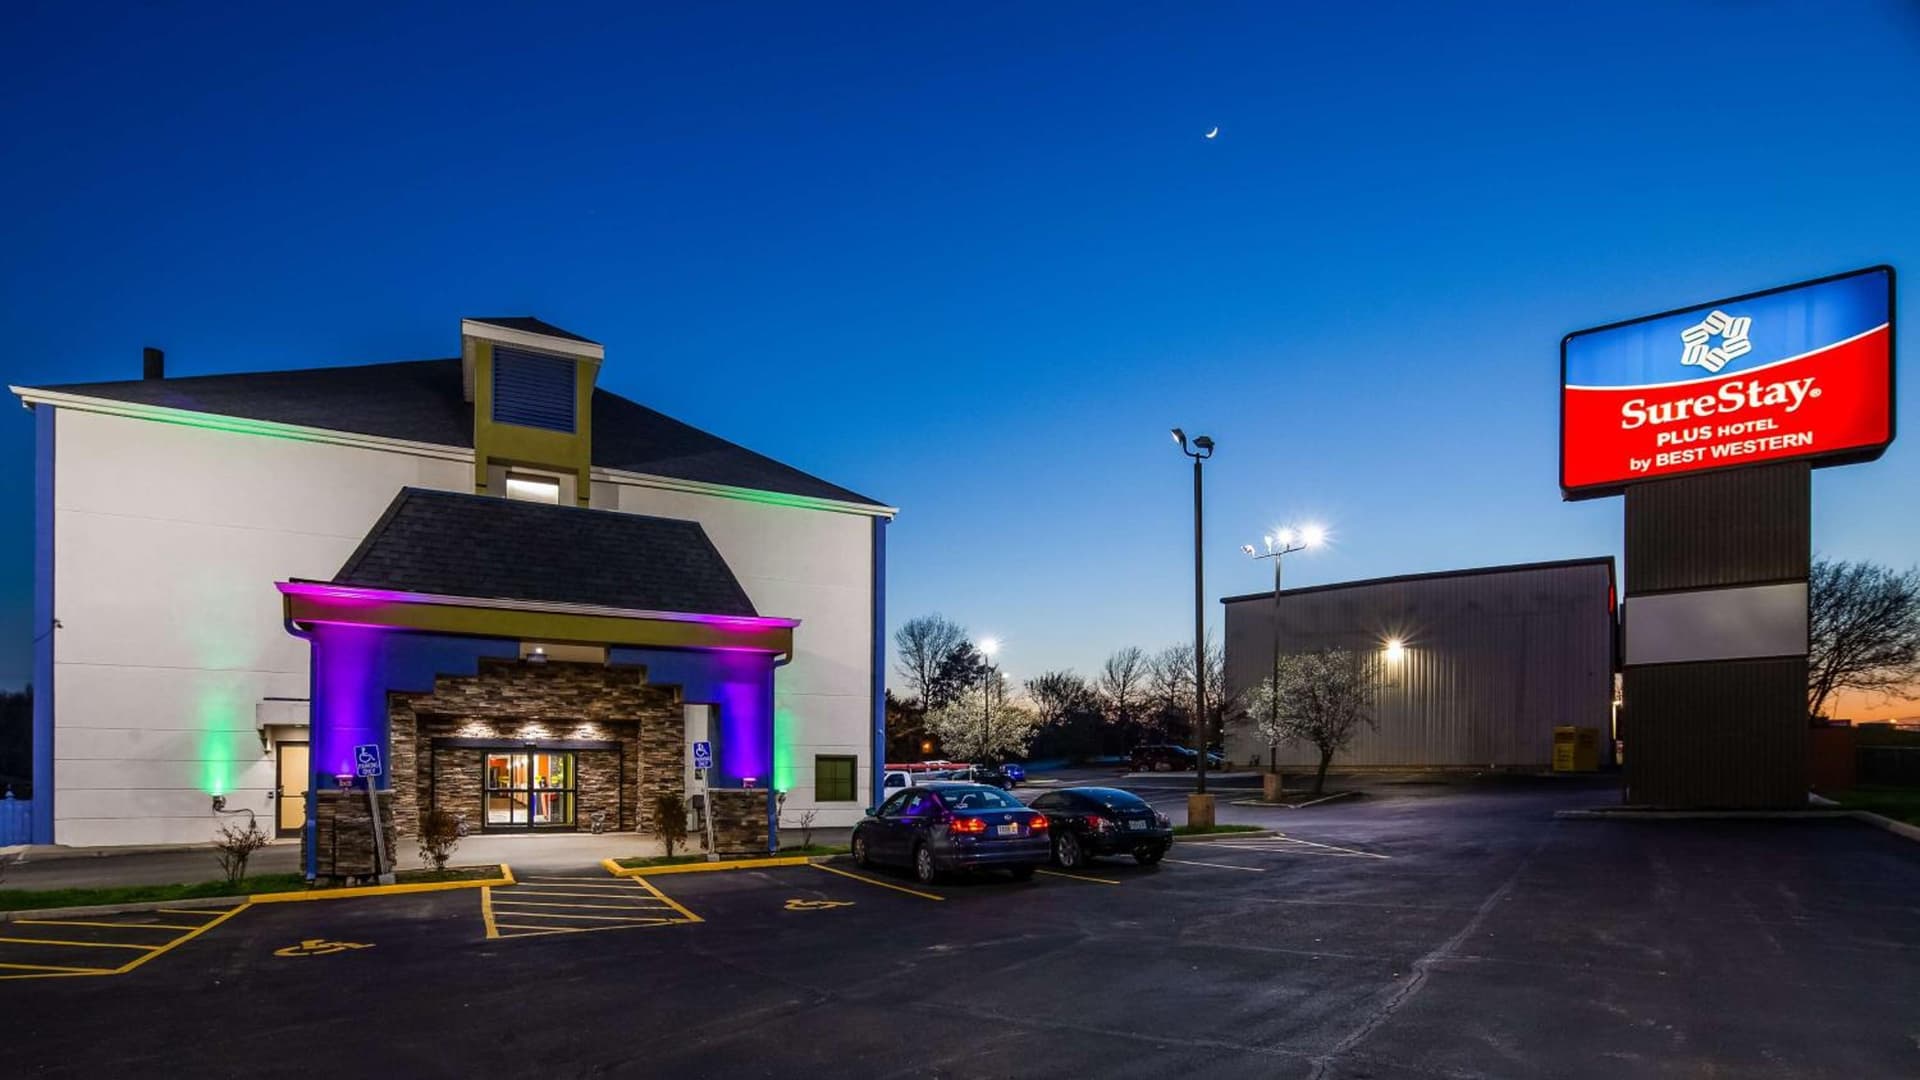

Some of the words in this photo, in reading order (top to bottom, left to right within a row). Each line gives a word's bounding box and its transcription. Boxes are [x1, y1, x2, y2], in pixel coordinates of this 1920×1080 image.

[1656, 426, 1712, 447] PLUS
[1717, 418, 1778, 438] HOTEL
[1629, 456, 1651, 472] by
[1656, 447, 1706, 466] BEST
[1711, 431, 1813, 458] WESTERN
